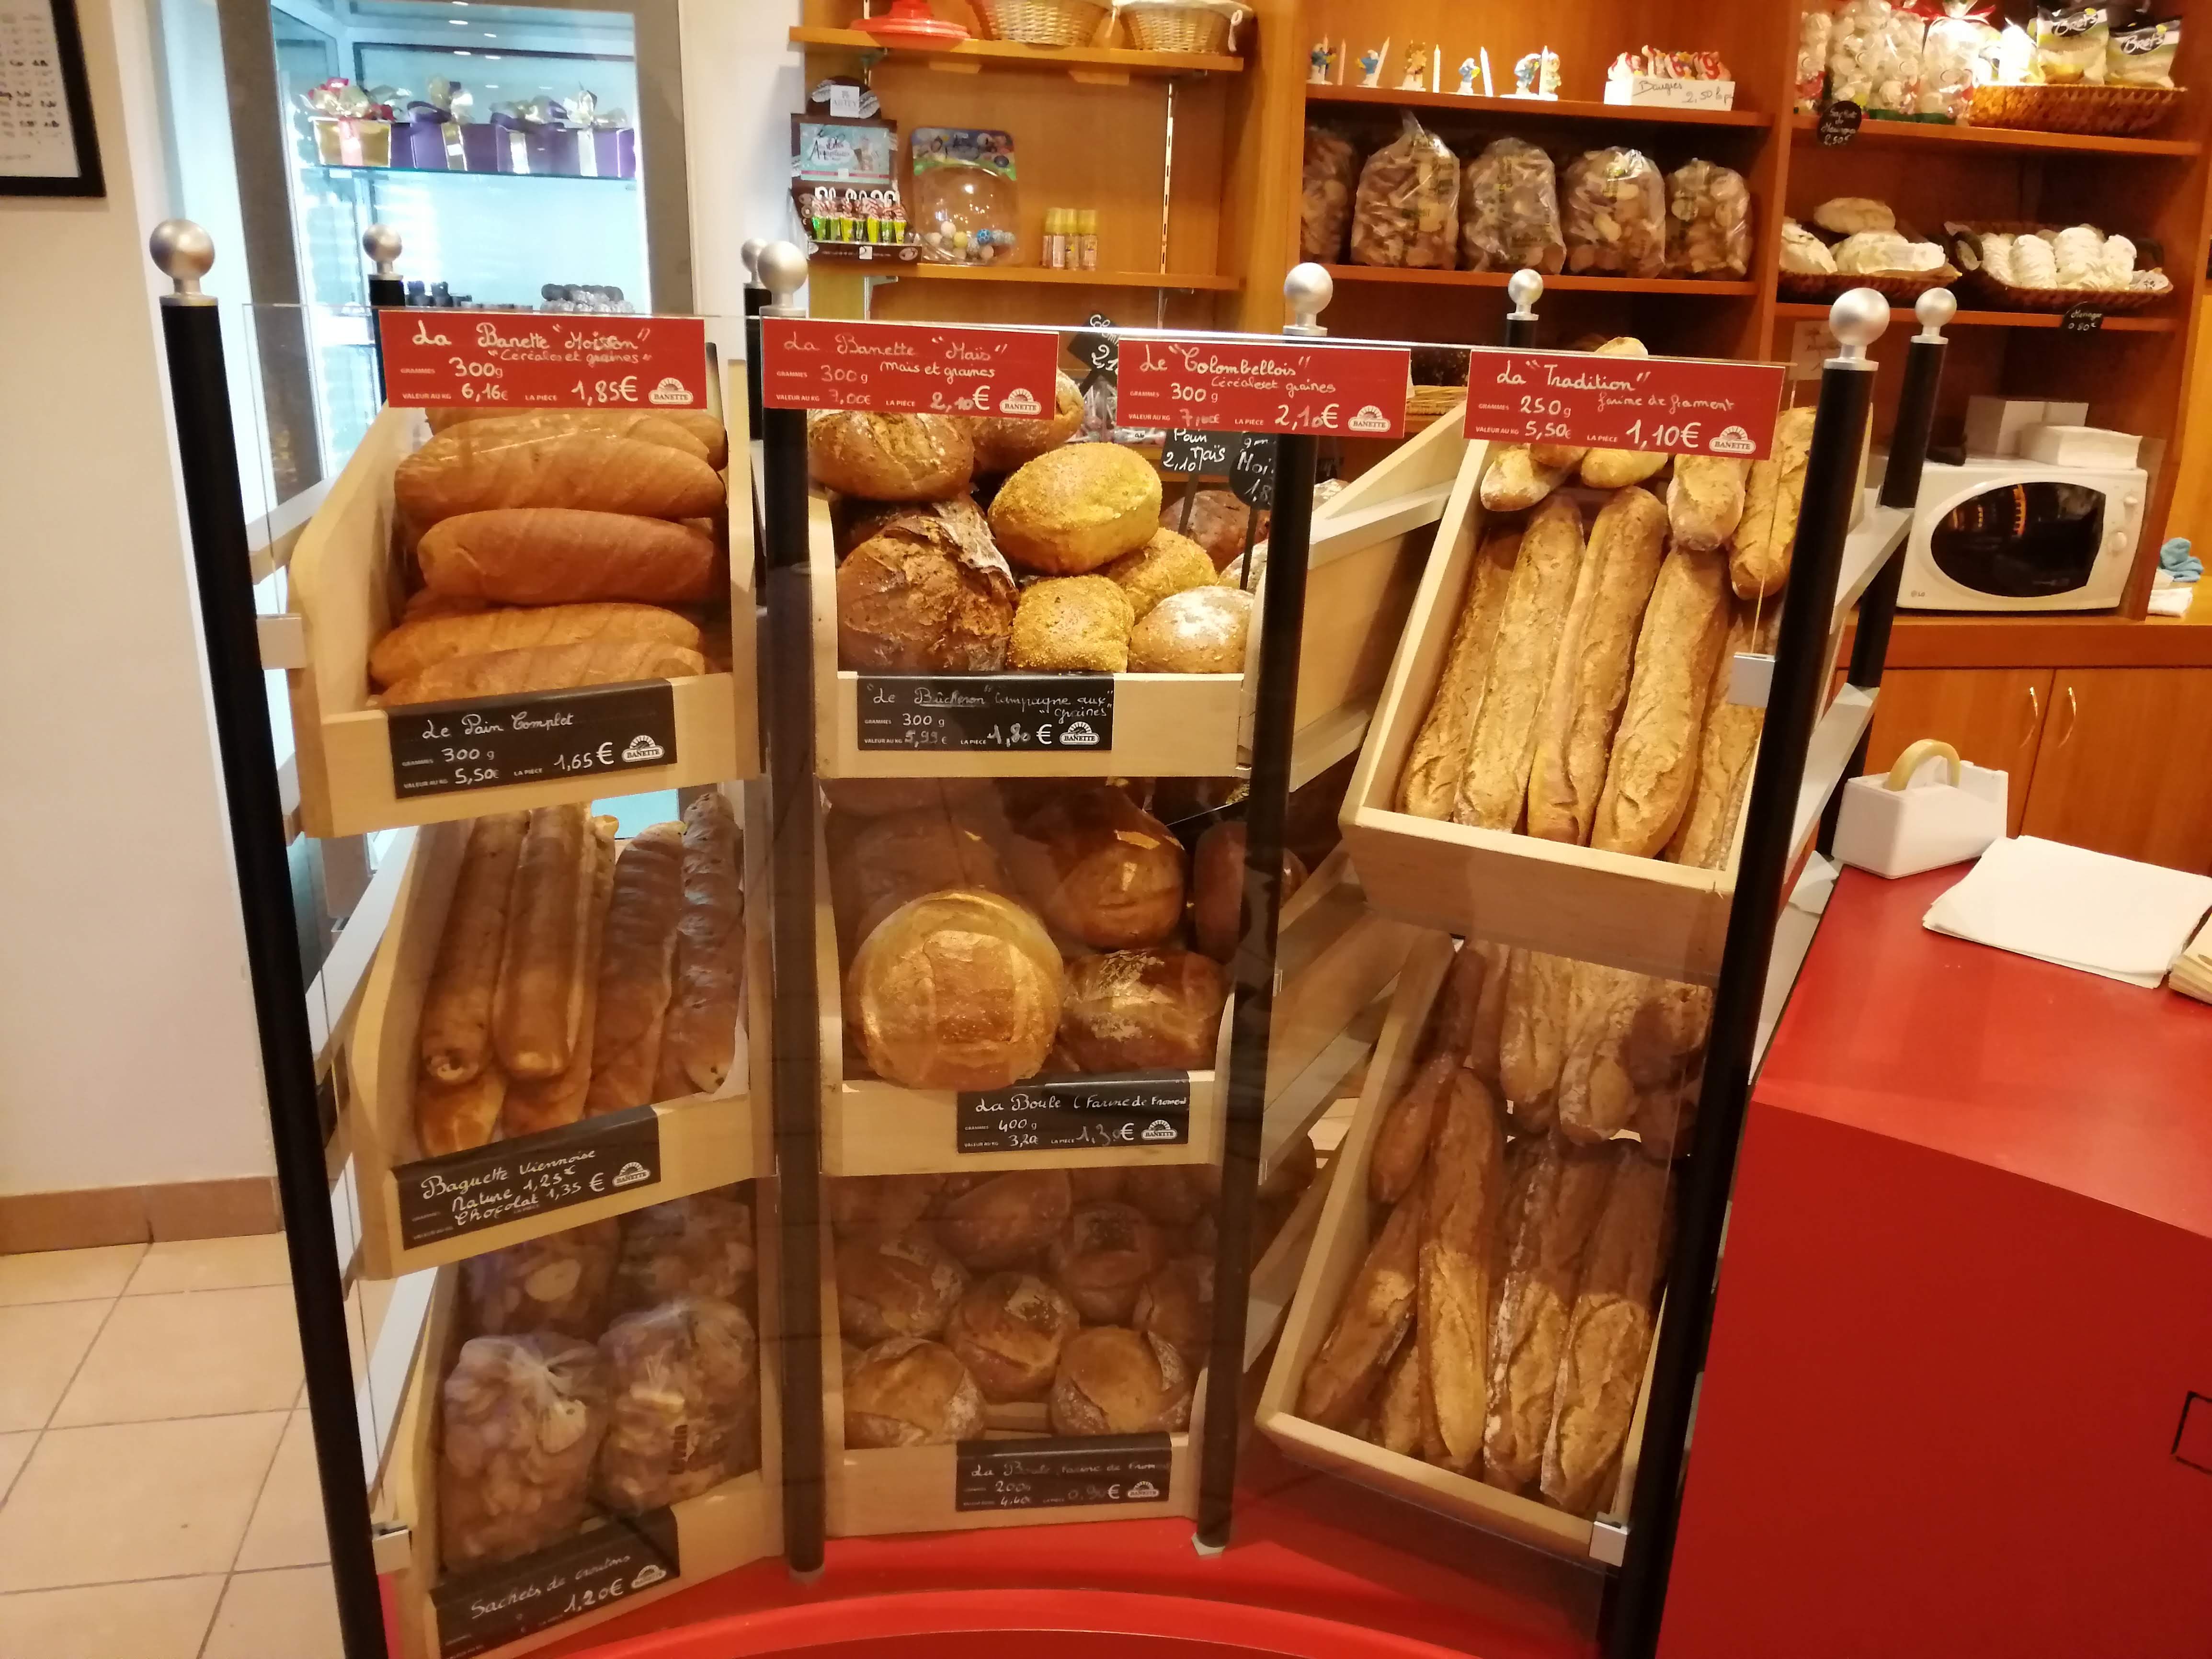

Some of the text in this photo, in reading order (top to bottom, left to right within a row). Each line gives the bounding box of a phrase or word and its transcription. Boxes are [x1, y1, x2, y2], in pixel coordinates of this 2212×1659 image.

[412, 319, 452, 345] La
[476, 322, 550, 349] Banette
[784, 331, 820, 351] La
[835, 332, 916, 356] Banette
[924, 362, 941, 375] et
[1140, 344, 1168, 372] Le
[1497, 360, 1527, 385] La
[461, 383, 509, 402] 6,16€
[571, 376, 639, 406] 1,85€
[1004, 403, 1037, 411] BANETTE
[1274, 403, 1339, 431] 2,10€
[1625, 419, 1701, 451] 1,10€
[1714, 441, 1751, 451] BANETTE
[422, 711, 574, 739] Le Pain Complet
[902, 713, 933, 726] 300
[441, 748, 480, 762] 300
[626, 749, 661, 759] BANETTE
[975, 1098, 1004, 1112] La
[1011, 1093, 1061, 1112] Boule
[999, 1119, 1027, 1132] 400
[421, 1150, 595, 1200] Baguette Viennoise
[455, 1193, 539, 1226] Chocolat
[471, 1585, 542, 1619] Sachets
